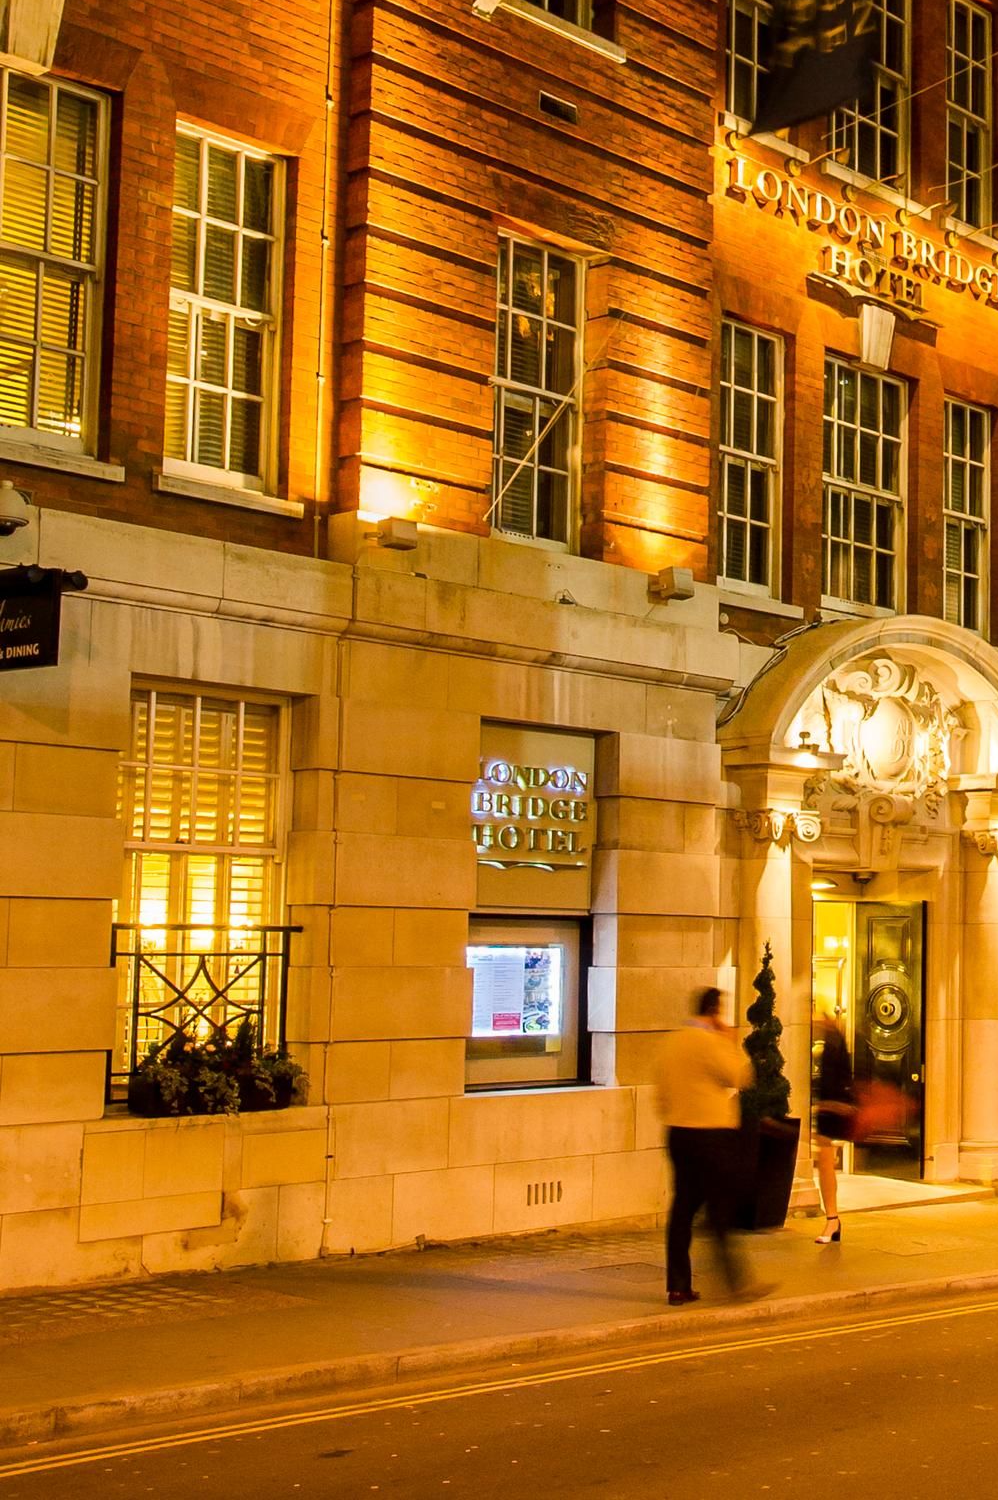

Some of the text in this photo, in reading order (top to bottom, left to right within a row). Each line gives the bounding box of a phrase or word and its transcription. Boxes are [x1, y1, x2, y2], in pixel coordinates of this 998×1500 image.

[733, 156, 887, 249] LONDON
[6, 643, 40, 659] DINING
[478, 760, 589, 791] LONDON
[473, 791, 588, 822] BRIDGE
[472, 823, 587, 854] HOTEL
